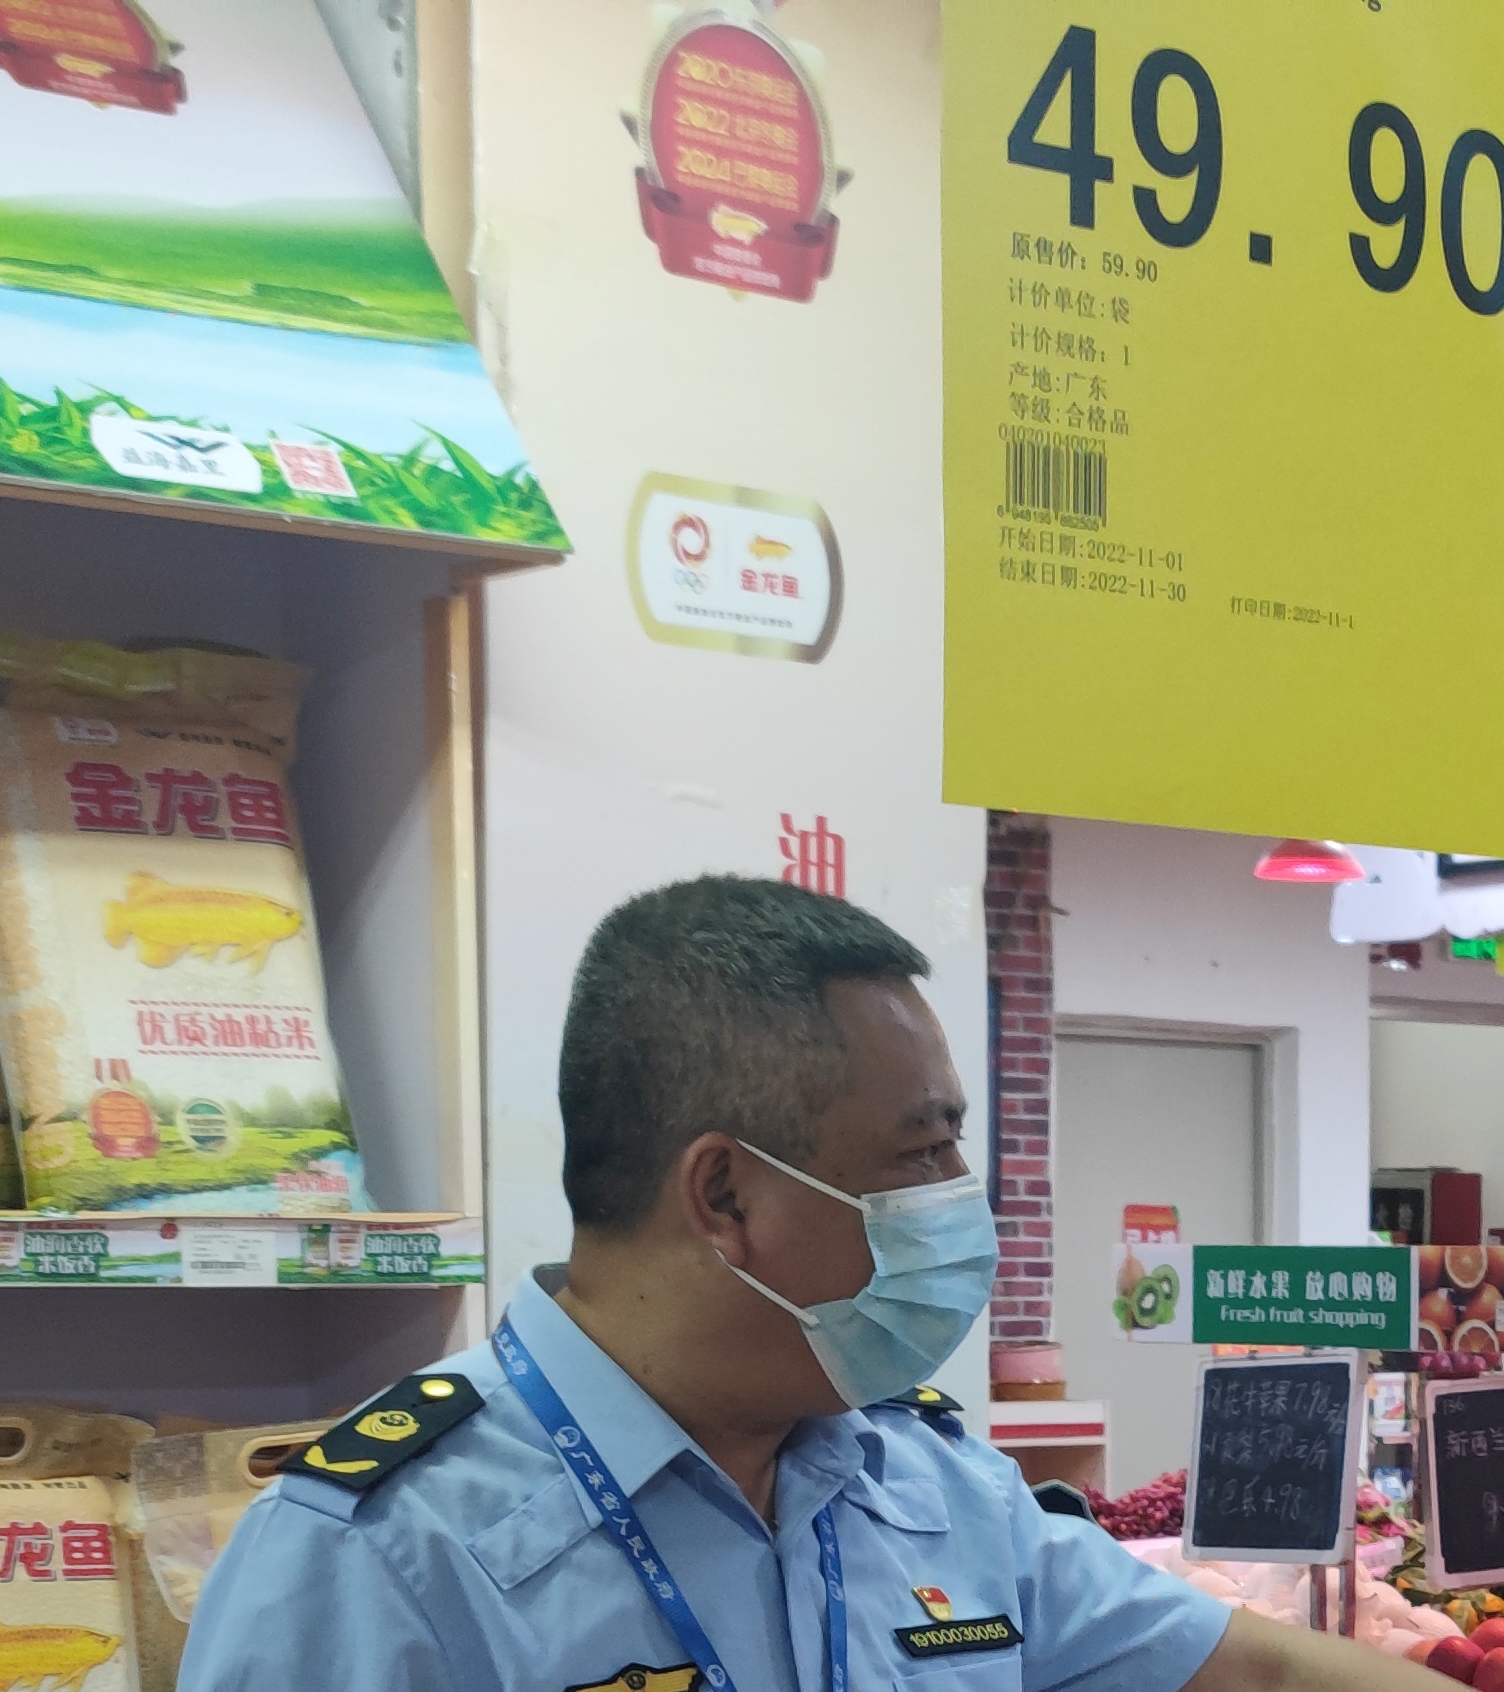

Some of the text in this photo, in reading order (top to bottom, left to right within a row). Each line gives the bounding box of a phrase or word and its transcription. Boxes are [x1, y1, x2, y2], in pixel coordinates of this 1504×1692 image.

[63, 761, 296, 850] 金龙鱼
[135, 1008, 317, 1052] 优质油粘米
[1204, 1268, 1291, 1301] 新鲜水果
[1219, 1304, 1386, 1332] Fresh fruit shopping
